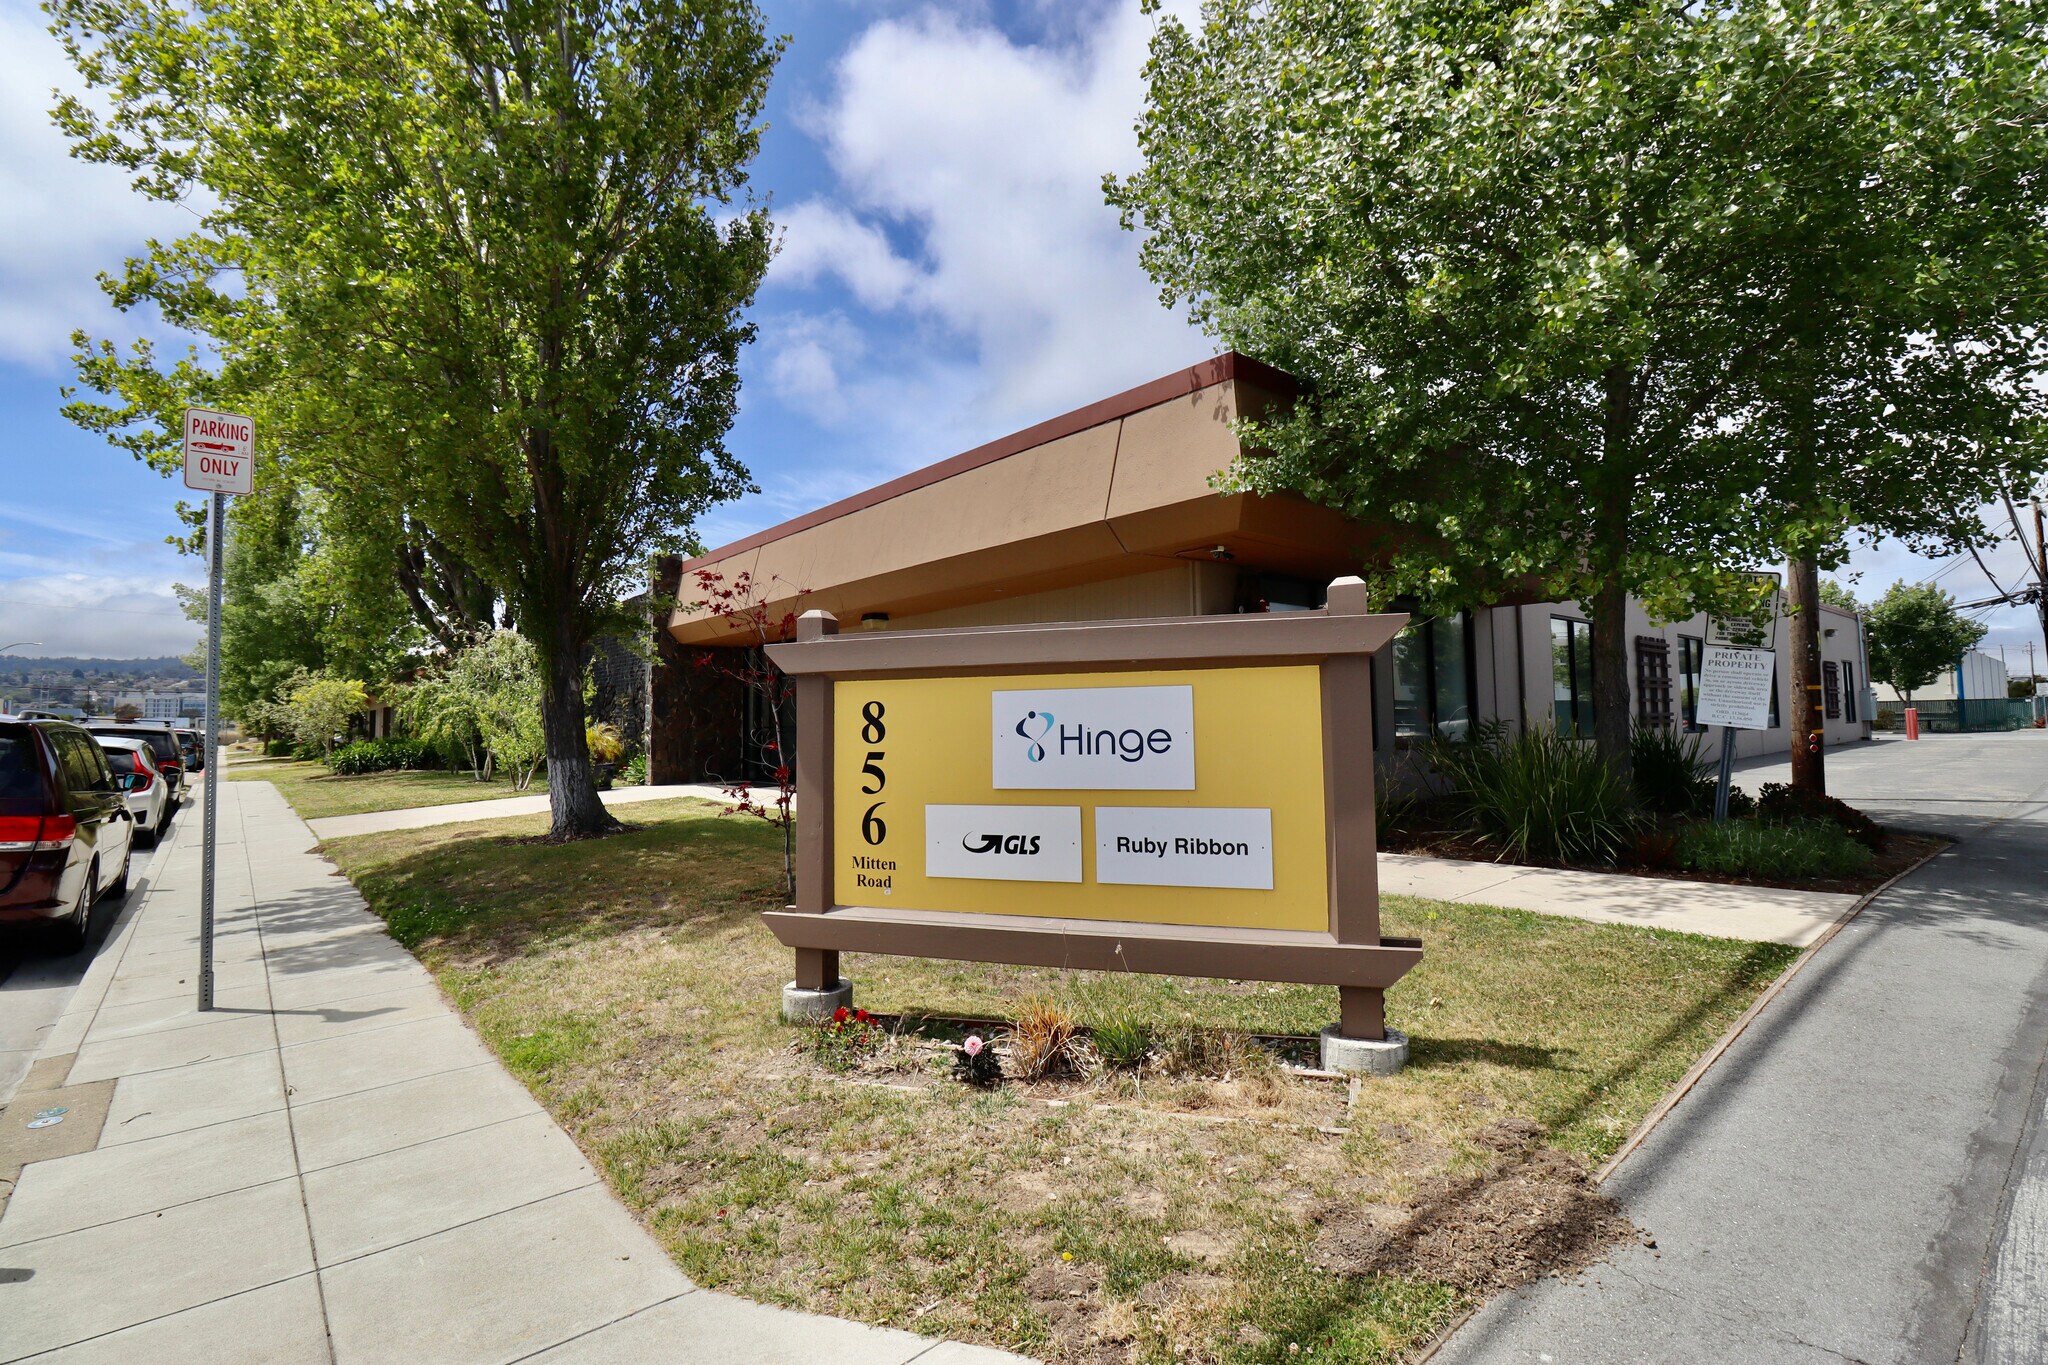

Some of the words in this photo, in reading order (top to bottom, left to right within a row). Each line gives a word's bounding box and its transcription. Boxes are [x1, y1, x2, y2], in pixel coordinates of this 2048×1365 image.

[192, 418, 249, 442] PARKING
[200, 457, 239, 476] ONLY
[1708, 660, 1767, 670] PROPERTY
[1715, 652, 1762, 661] PRIVATE
[1060, 724, 1172, 762] Hinge
[862, 701, 886, 845] 856
[1004, 835, 1041, 855] GLS
[1117, 837, 1168, 858] Ruby
[1175, 838, 1249, 856] Ribbon
[852, 856, 897, 871] Mitten
[857, 874, 892, 888] Road
